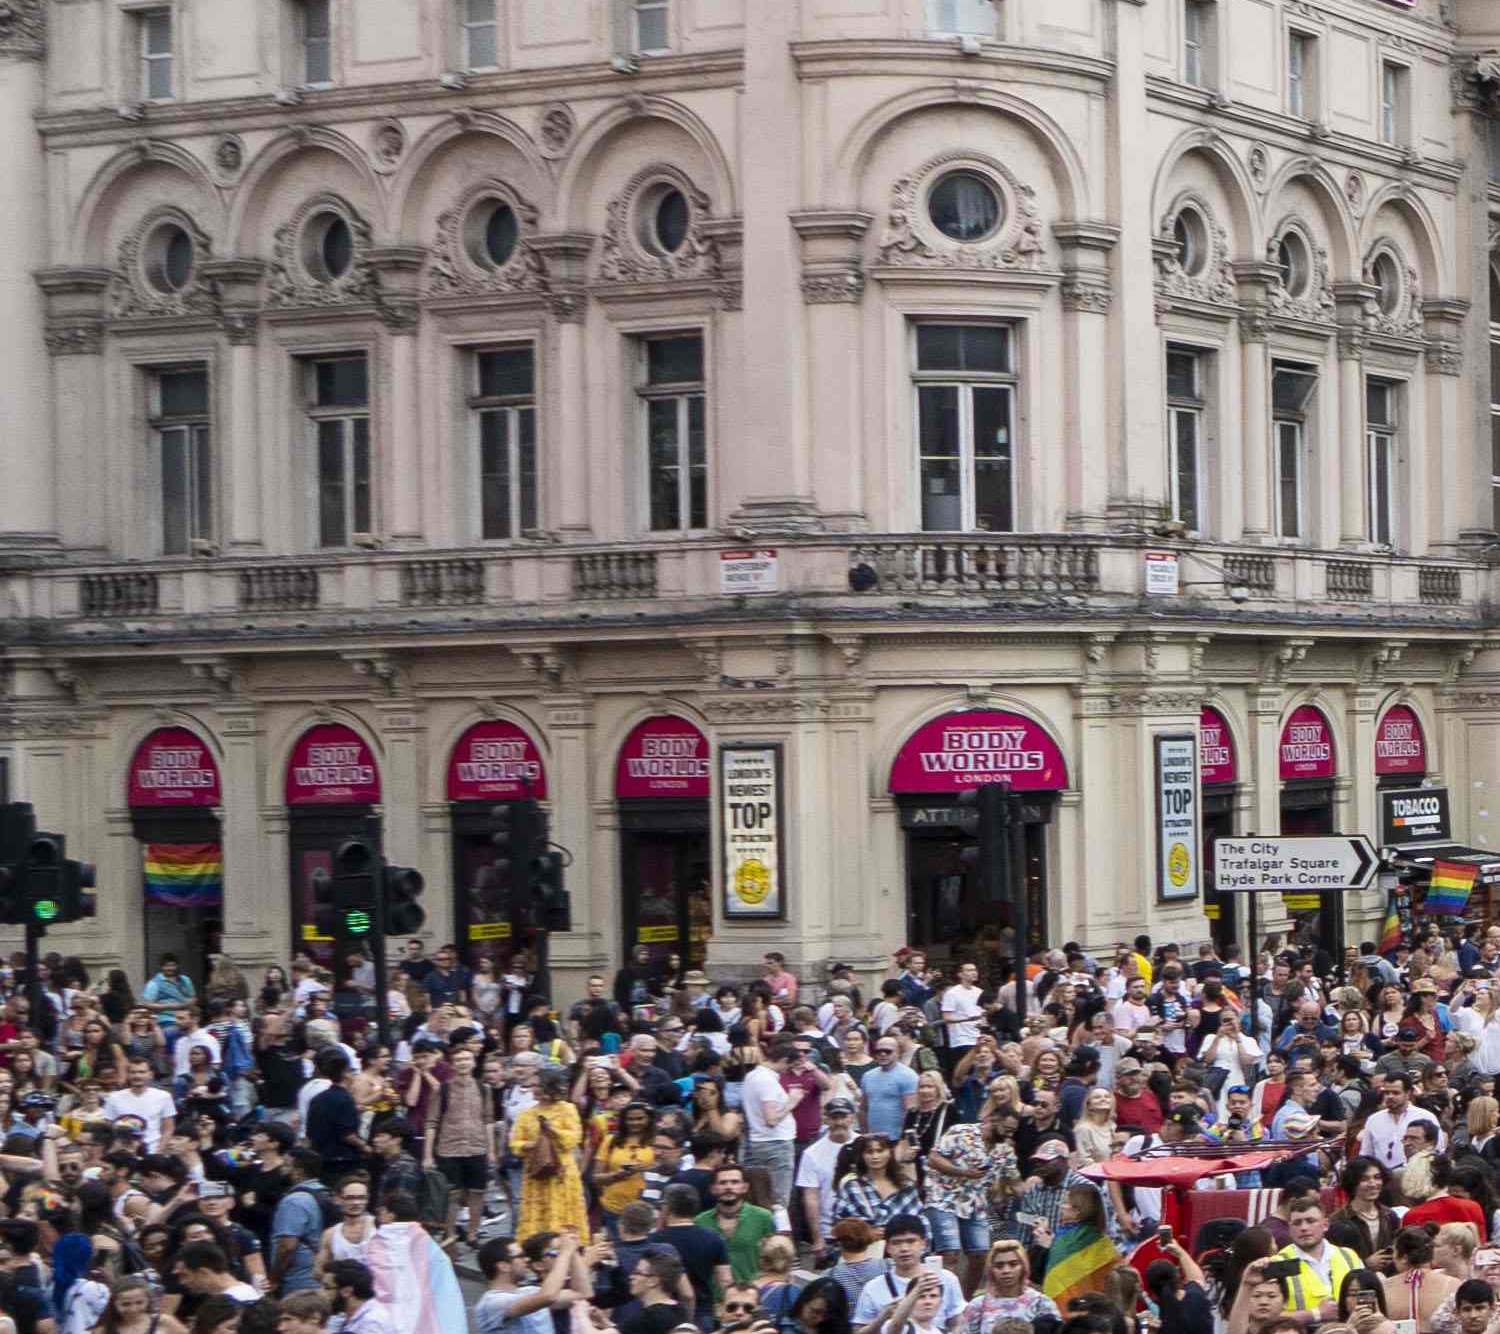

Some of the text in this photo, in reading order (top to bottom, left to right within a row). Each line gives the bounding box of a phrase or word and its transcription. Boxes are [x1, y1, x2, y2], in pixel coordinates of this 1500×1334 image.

[943, 729, 1027, 751] BODY
[1290, 727, 1326, 745] BODY
[1385, 723, 1415, 738] BODY
[310, 745, 362, 765] BODY
[474, 741, 526, 762] BODY
[645, 738, 700, 758] BODY
[1281, 744, 1332, 763] WORLDS
[1377, 738, 1421, 756] WORLDS
[153, 749, 203, 768] BODY
[629, 758, 713, 778] WORLDS
[921, 750, 1044, 772] WORLDS
[140, 768, 215, 788] WORLDS
[296, 766, 373, 786] WORLDS
[459, 762, 541, 782] WORLDS
[955, 774, 1013, 784] LONDON
[1164, 772, 1192, 784] NEWEST
[729, 784, 773, 797] NEWEST
[1165, 789, 1192, 815] TOP
[1392, 796, 1440, 817] TOBACCO
[730, 802, 772, 829] TOP
[1221, 842, 1280, 857] The City
[1221, 857, 1341, 873] Trafalgar Square
[1221, 871, 1346, 888] Hyde Park Corner
